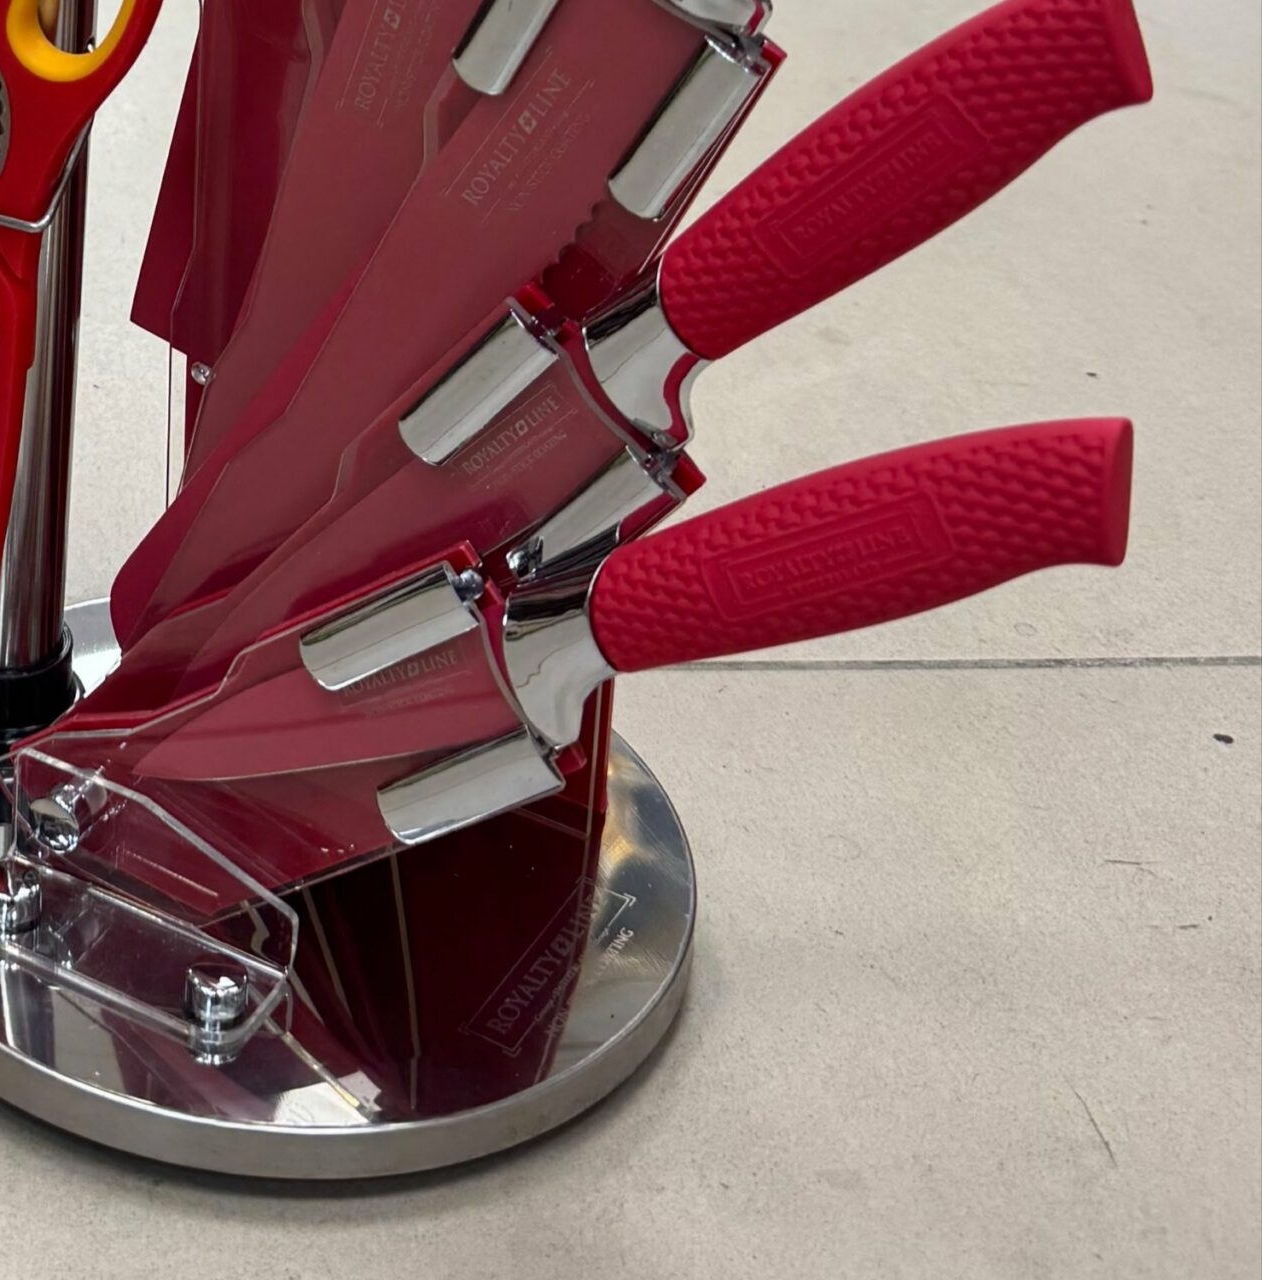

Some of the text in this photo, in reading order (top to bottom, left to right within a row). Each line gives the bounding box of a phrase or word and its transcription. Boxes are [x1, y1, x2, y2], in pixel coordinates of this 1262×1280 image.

[461, 68, 571, 206] ROYALTY LINE
[461, 396, 560, 476] ROYALTY LINE
[486, 948, 557, 1035] ROYALTY
